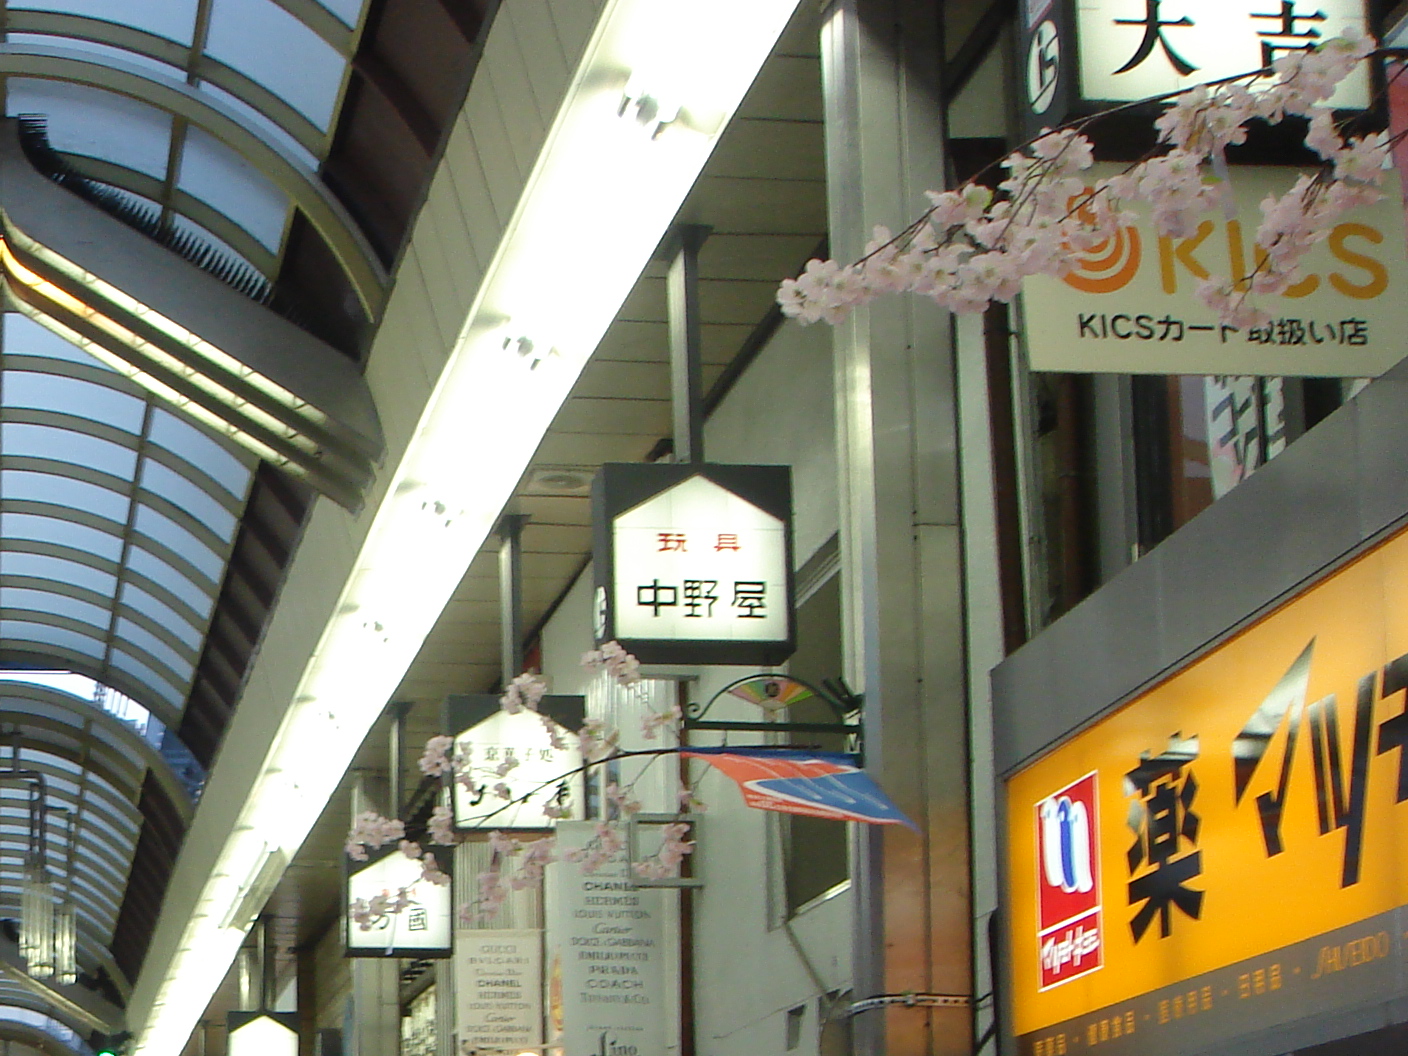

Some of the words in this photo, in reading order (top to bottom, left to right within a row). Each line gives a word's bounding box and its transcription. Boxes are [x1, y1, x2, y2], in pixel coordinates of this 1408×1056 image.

[656, 533, 741, 553] 玩具
[637, 578, 767, 619] 中野屋
